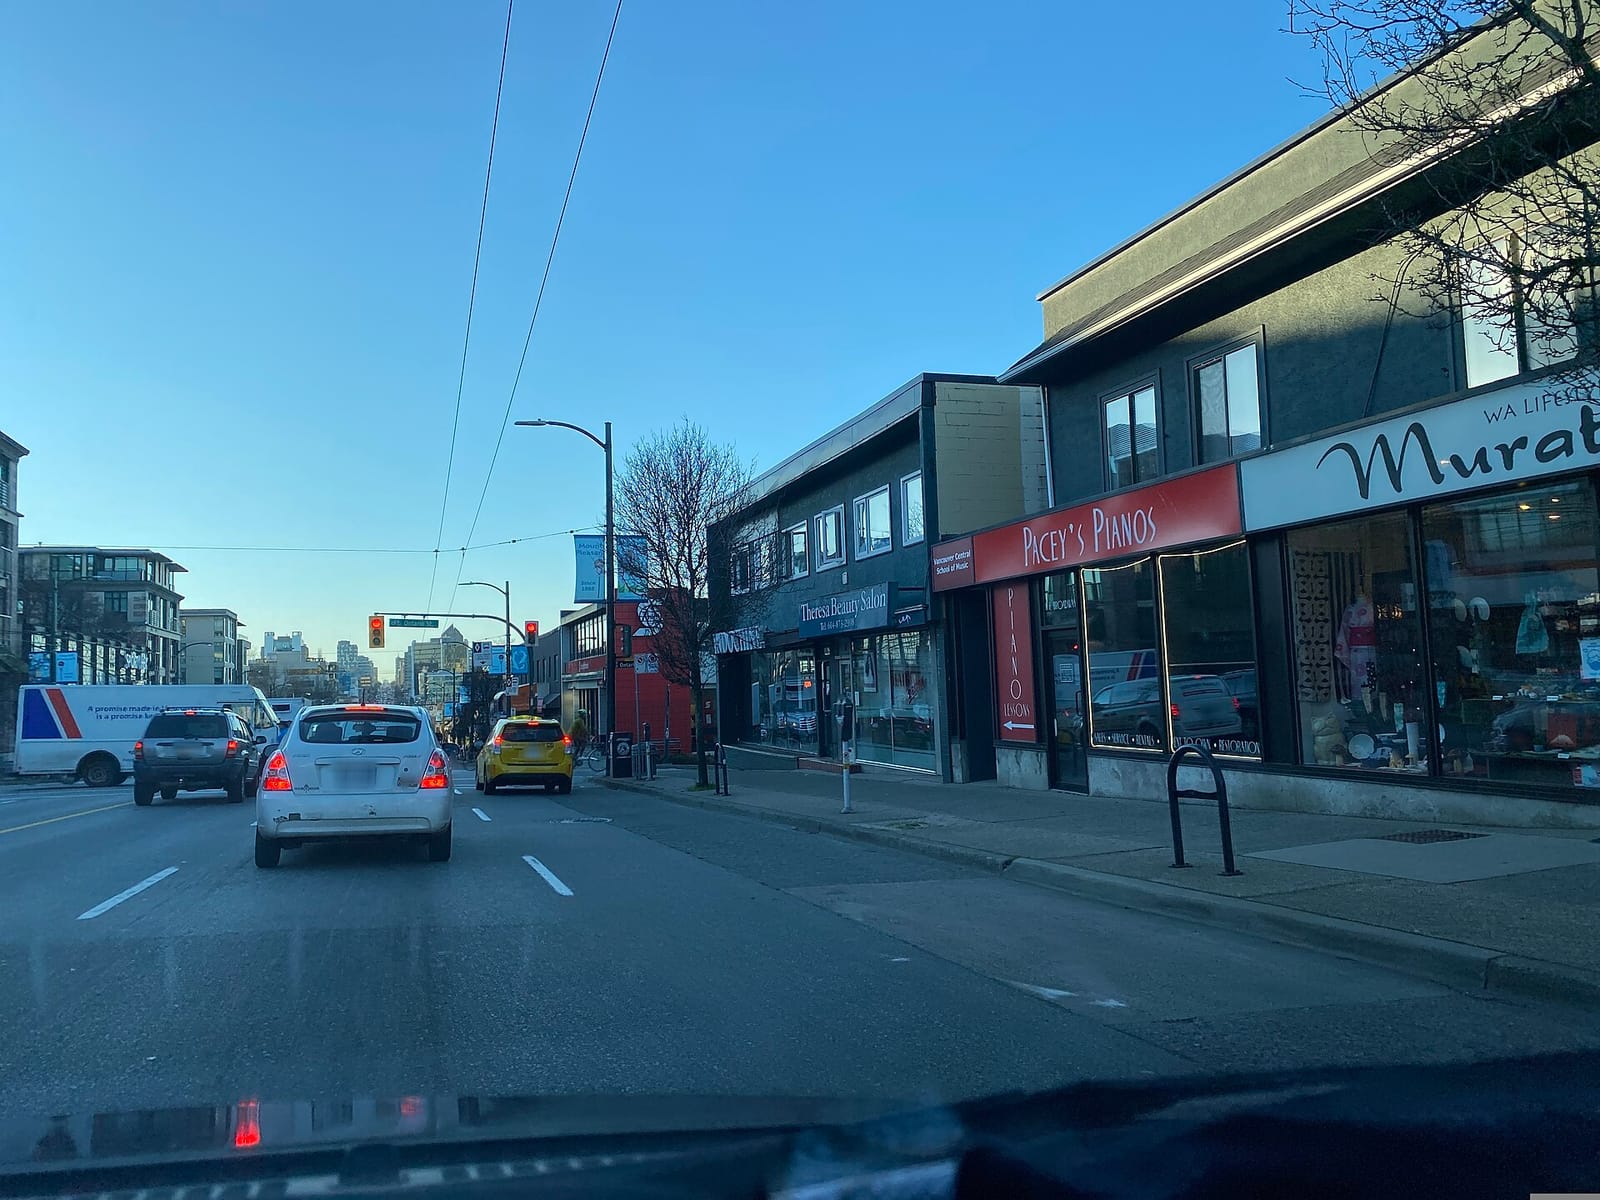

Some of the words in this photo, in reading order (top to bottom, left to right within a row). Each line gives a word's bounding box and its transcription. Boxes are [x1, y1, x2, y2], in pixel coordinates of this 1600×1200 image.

[1483, 403, 1517, 424] WA
[1023, 523, 1085, 567] PACEY'S
[1092, 506, 1157, 553] PIANOS
[933, 554, 955, 566] Vancouver
[955, 549, 971, 560] Central
[936, 564, 950, 575] School
[951, 563, 955, 572] of
[956, 560, 969, 571] Music
[801, 602, 830, 622] Theresa
[831, 597, 861, 618] Beauty
[860, 588, 886, 611] Salon
[1008, 588, 1022, 700] PIANO
[95, 706, 128, 714] promise
[1003, 703, 1030, 718] LESSONS
[1218, 739, 1261, 755] RESTORATION
